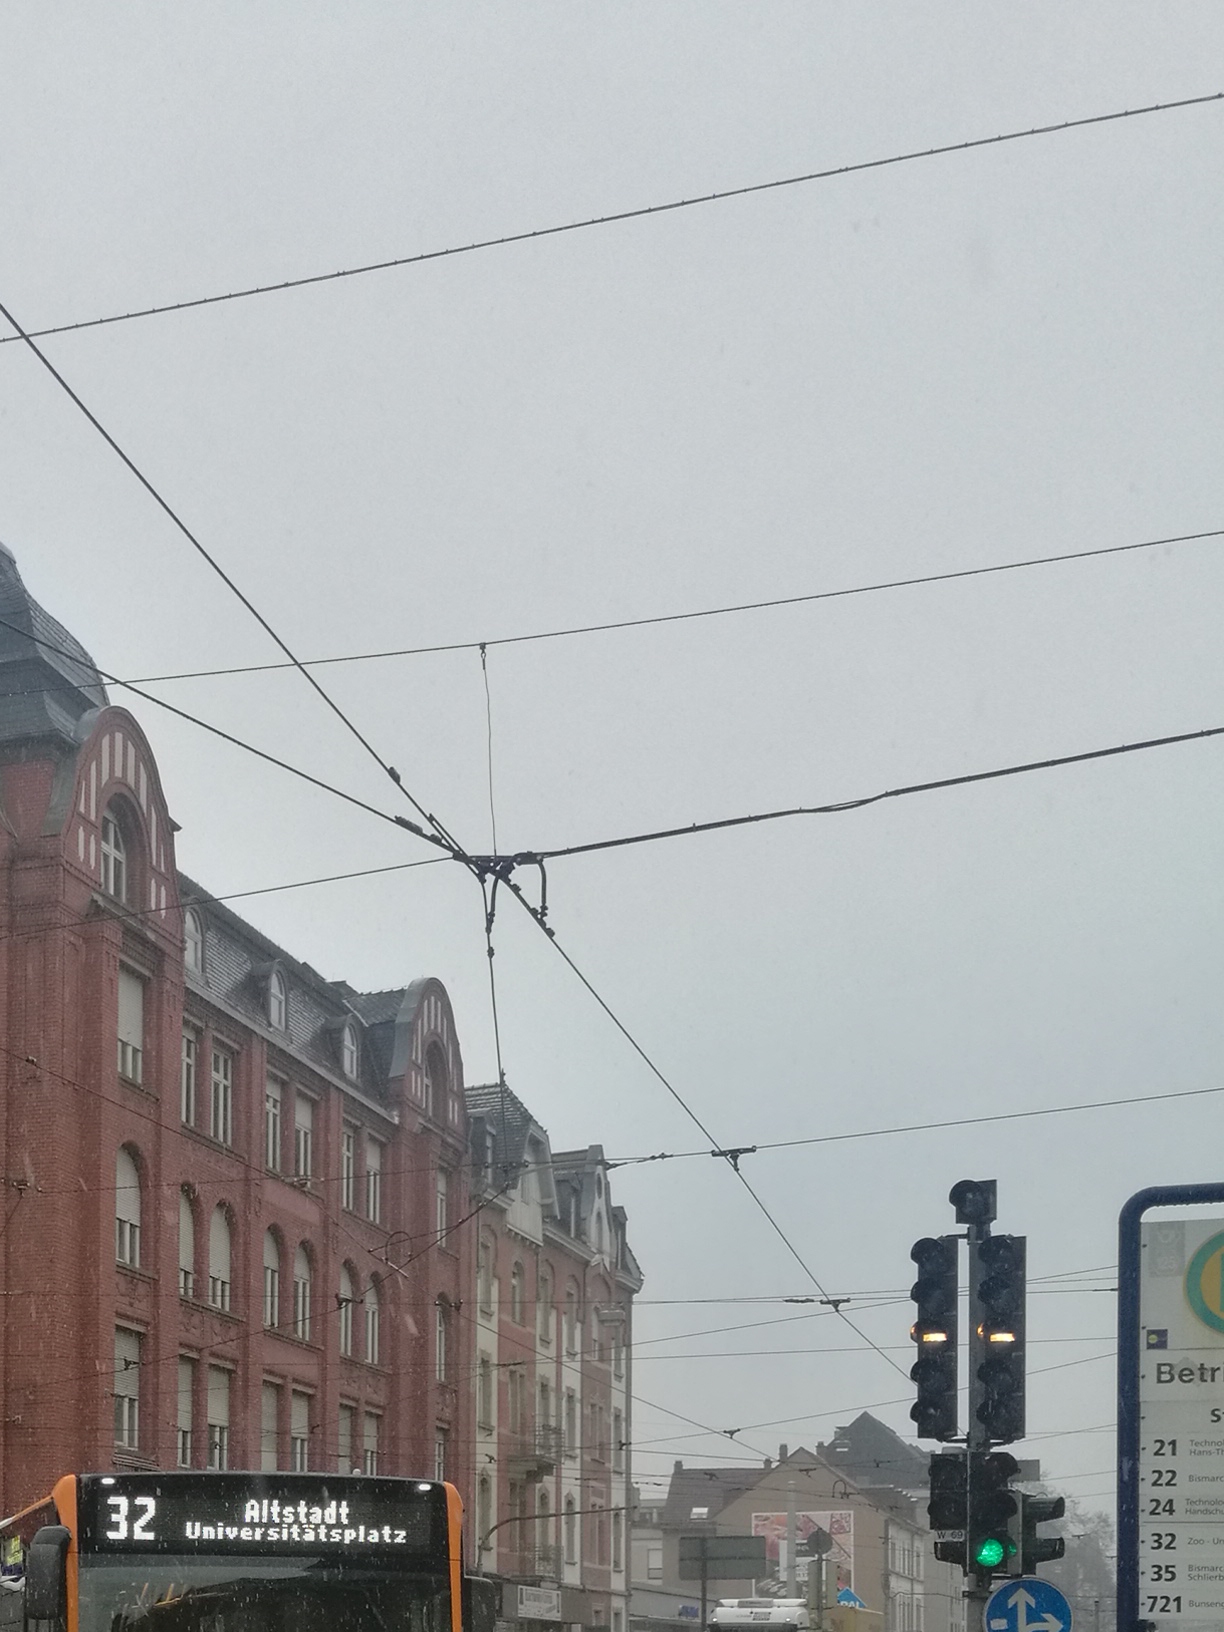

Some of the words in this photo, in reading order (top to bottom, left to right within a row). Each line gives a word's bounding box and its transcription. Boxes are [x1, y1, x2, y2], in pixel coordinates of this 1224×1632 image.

[1153, 1439, 1177, 1456] 21
[1151, 1469, 1177, 1487] 22
[244, 1499, 350, 1525] Altstadt
[1149, 1498, 1175, 1516] 24
[106, 1496, 156, 1541] 32
[185, 1521, 407, 1545] Universitätsplatz
[937, 1531, 947, 1539] W
[950, 1530, 963, 1539] 69
[1150, 1532, 1177, 1550] 32
[1187, 1537, 1205, 1545] Zoo
[1150, 1564, 1177, 1582] 35
[1147, 1595, 1182, 1613] 721
